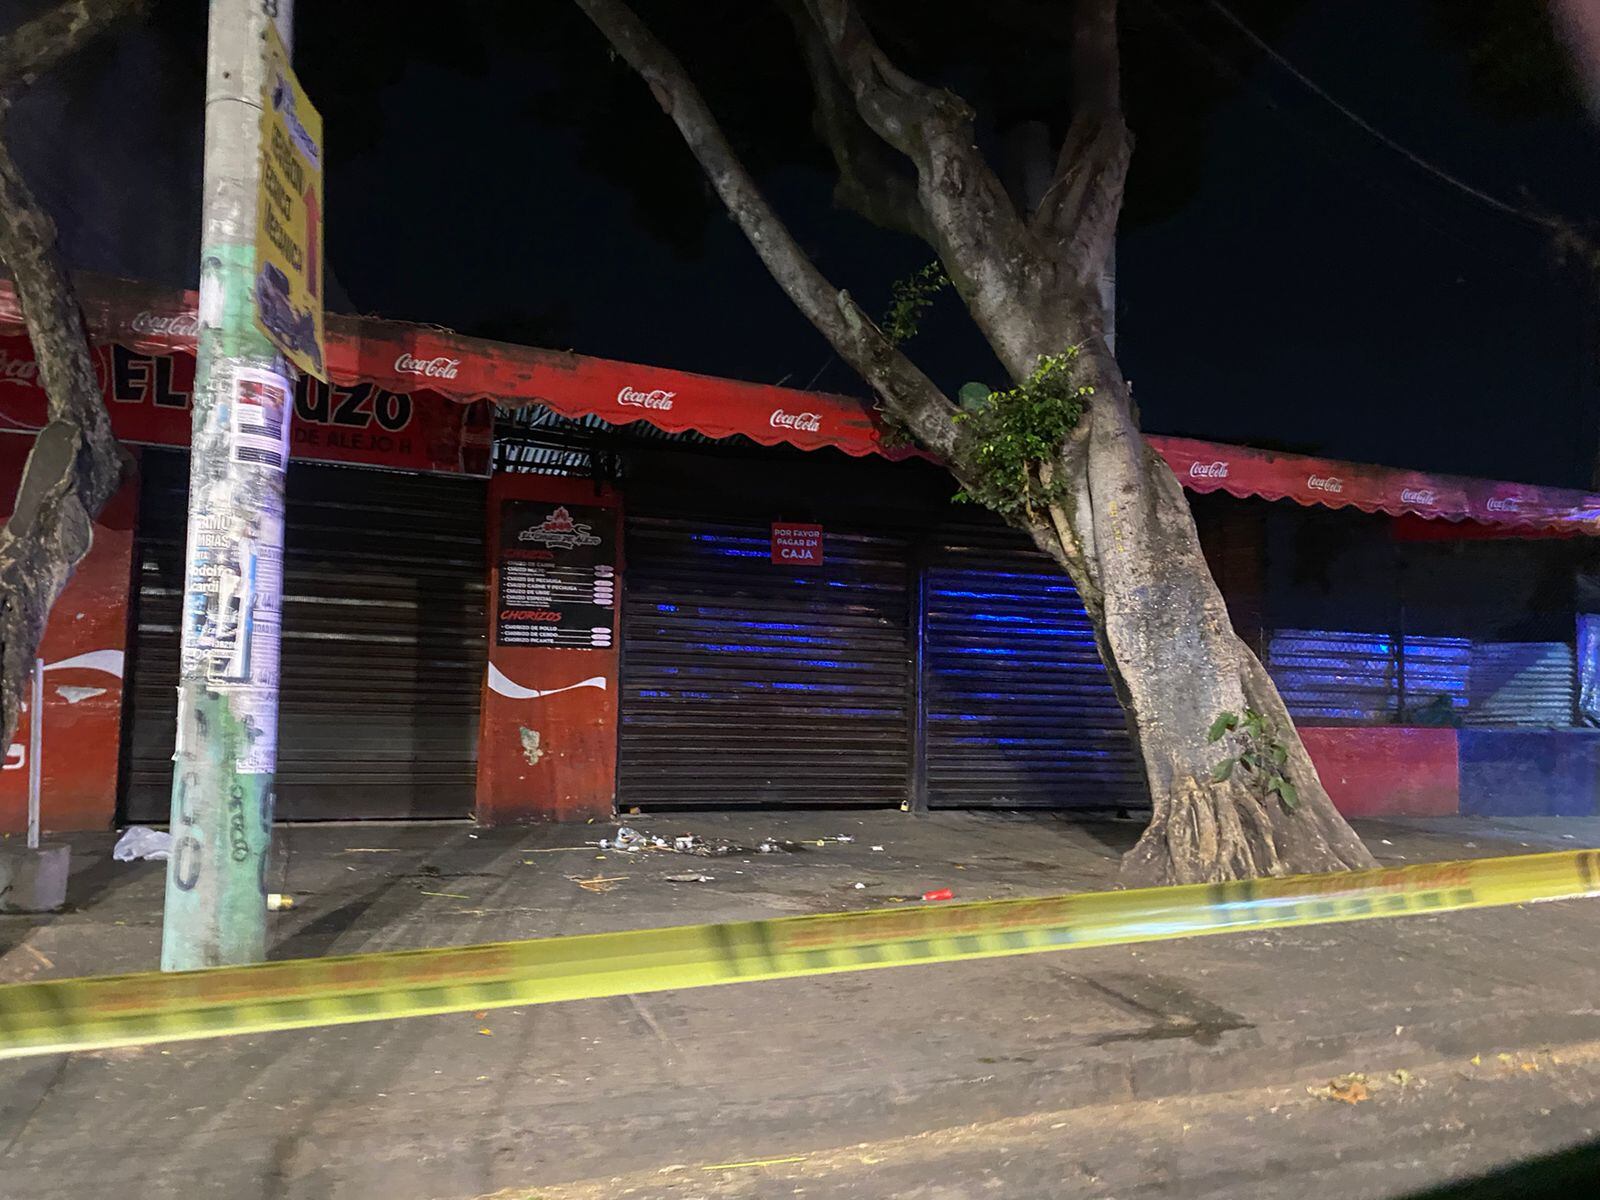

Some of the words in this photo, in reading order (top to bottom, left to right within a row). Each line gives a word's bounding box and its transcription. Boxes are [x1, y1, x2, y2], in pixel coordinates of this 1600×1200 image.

[111, 344, 190, 410] EL
[294, 374, 413, 432] UZO
[793, 529, 820, 537] FAVOR
[805, 539, 818, 547] EN
[781, 548, 814, 559] CAJA
[500, 609, 562, 621] CHORIZOS
